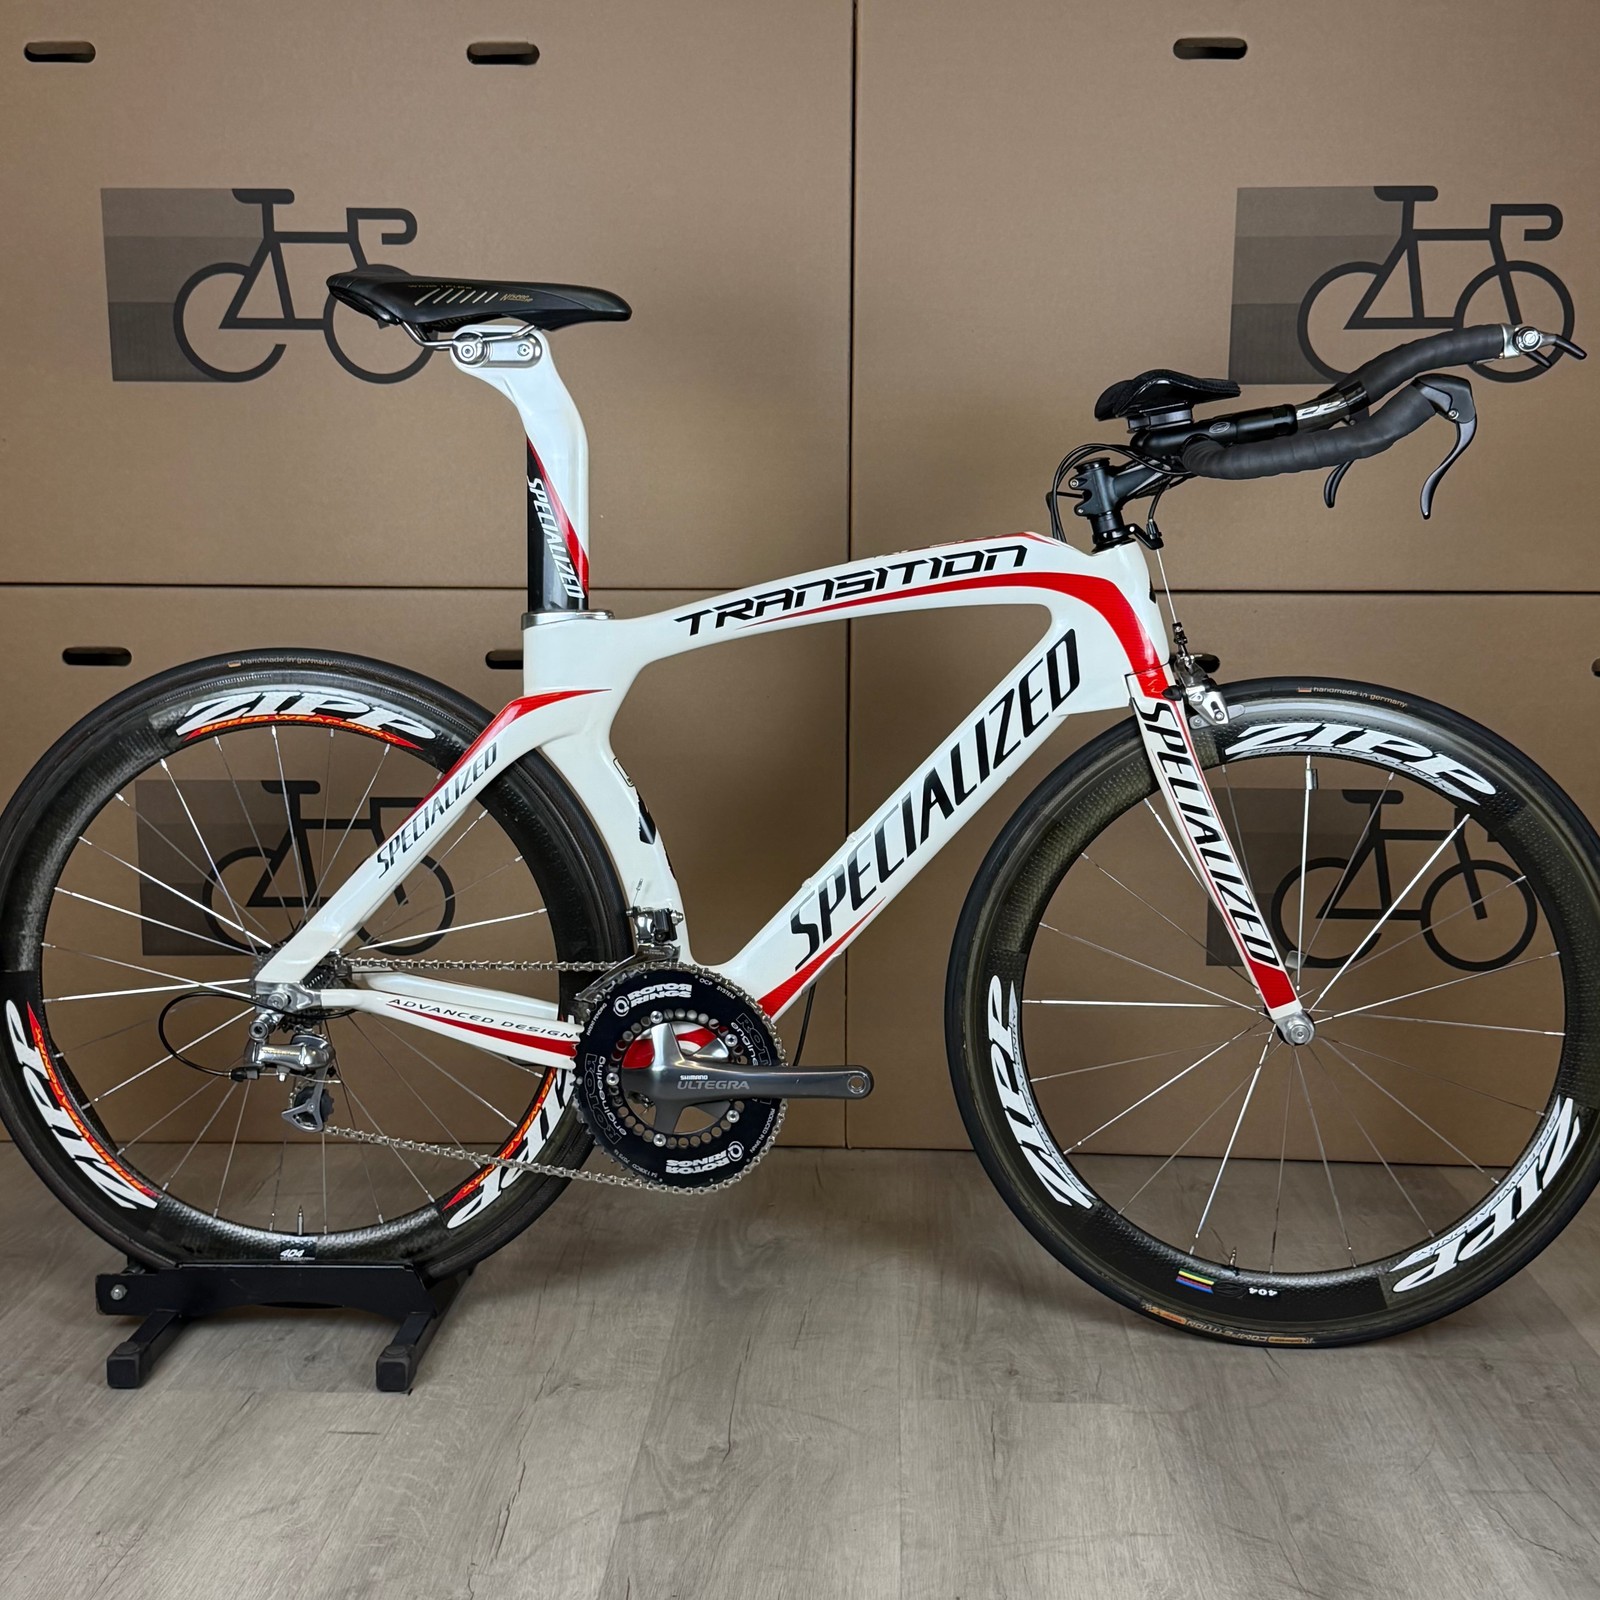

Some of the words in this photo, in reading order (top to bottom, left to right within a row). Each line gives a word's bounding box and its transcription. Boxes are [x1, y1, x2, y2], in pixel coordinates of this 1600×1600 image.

[527, 475, 585, 599] SPECIALIZED
[674, 545, 1028, 636] TRANSITION
[175, 691, 437, 740] ZIPP
[1313, 686, 1358, 696] handmade
[1369, 693, 1408, 708] germany
[199, 715, 269, 734] SPEED
[275, 714, 399, 743] WEAPONRY
[1225, 722, 1497, 795] ZIPP
[377, 742, 497, 879] SPECIALIZED
[790, 629, 1080, 971] SPECIALIZED
[1133, 698, 1280, 967] SPECIALIZED
[627, 983, 693, 1000] ROTOR
[630, 991, 692, 1008] RINGS
[716, 985, 736, 1000] SYSTEM
[389, 998, 495, 1024] ADVANCED
[501, 1021, 574, 1039] DESIGN
[6, 1000, 159, 1209] ZIPP
[584, 1053, 622, 1144] ROTOR
[596, 1056, 627, 1136] engineering
[677, 1080, 750, 1090] ULTEGRA
[988, 975, 1094, 1209] ZIPP
[665, 1150, 727, 1167] RINGS
[665, 1157, 730, 1174] ROTOR
[1393, 1097, 1581, 1293] ZIPP
[279, 1248, 305, 1258] 404
[1248, 1287, 1278, 1297] 404
